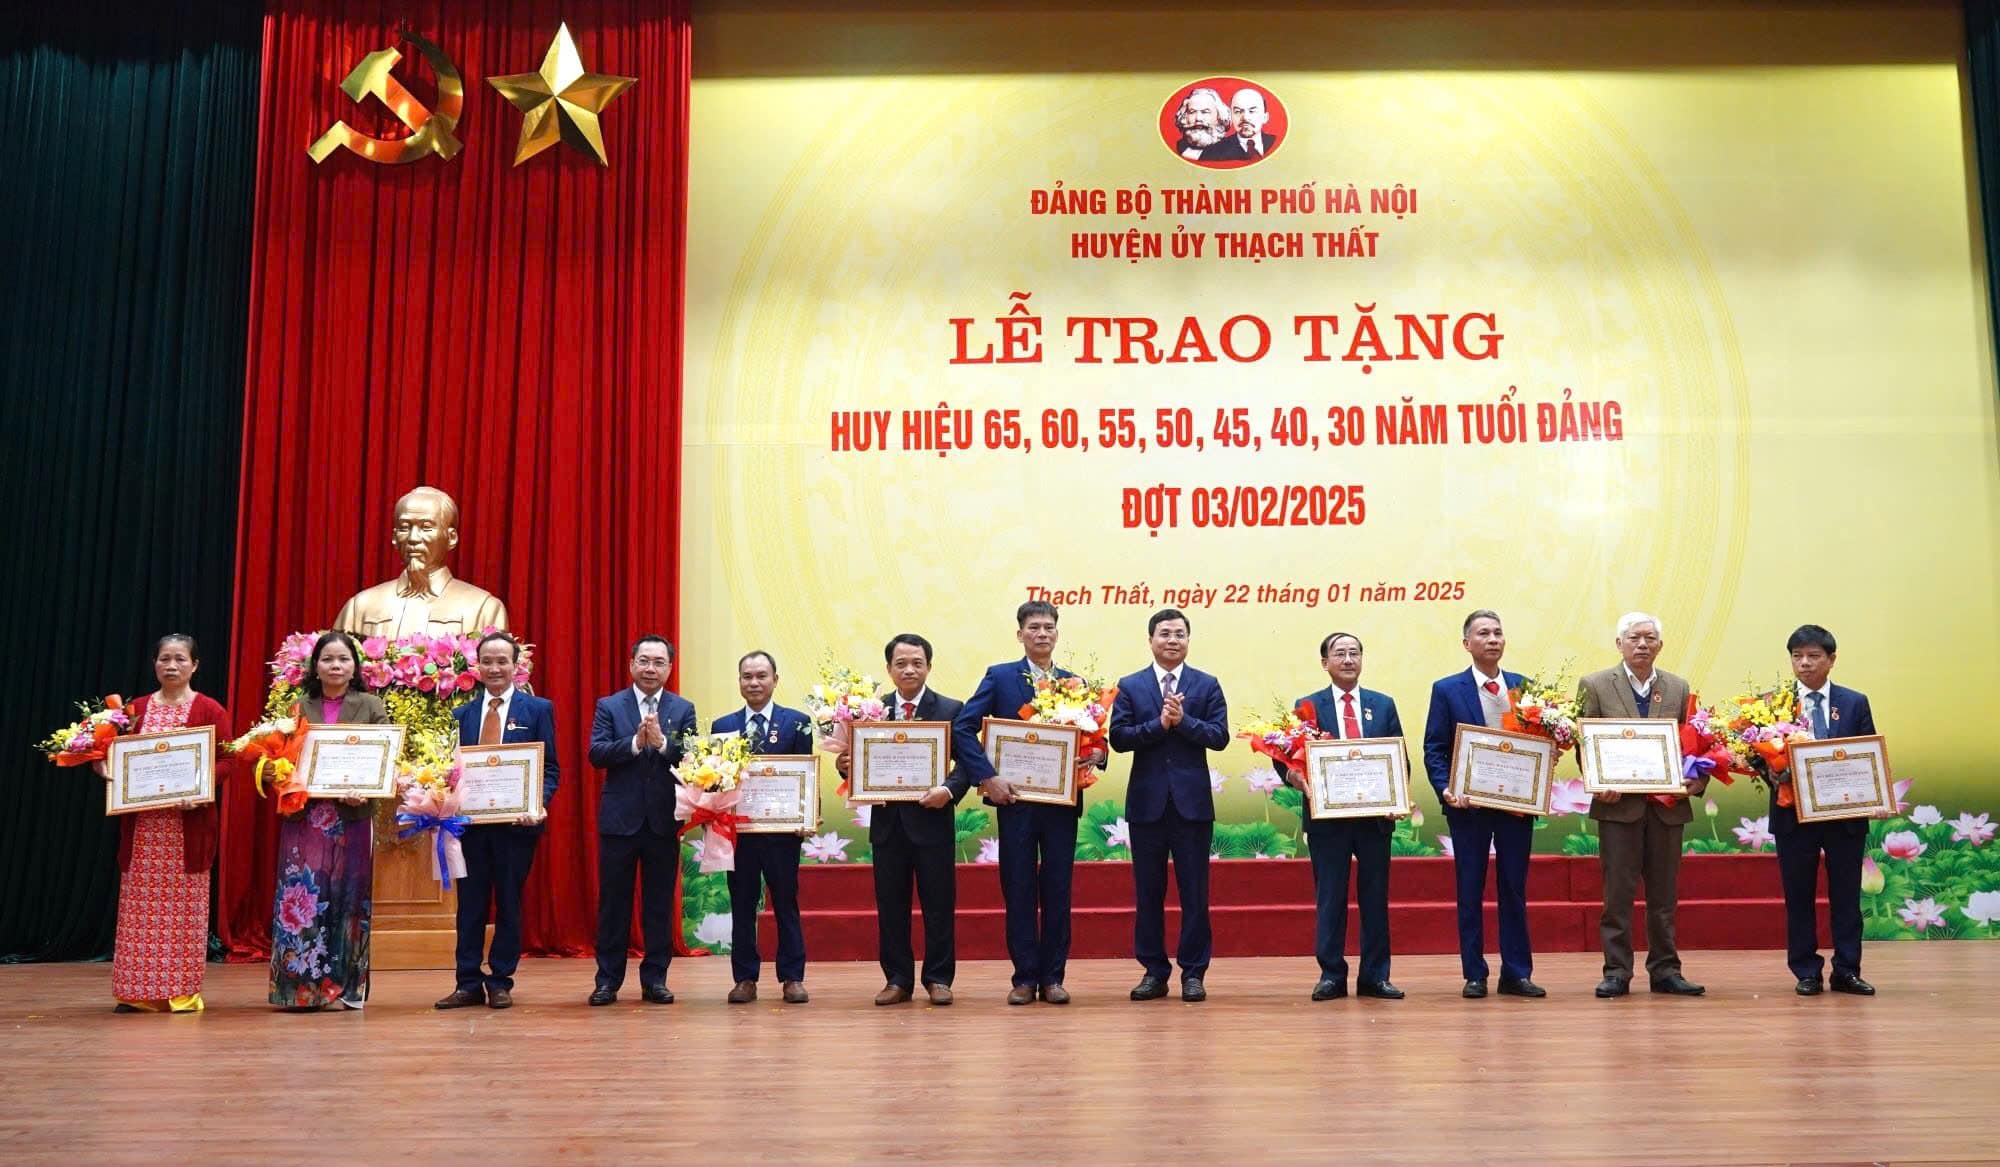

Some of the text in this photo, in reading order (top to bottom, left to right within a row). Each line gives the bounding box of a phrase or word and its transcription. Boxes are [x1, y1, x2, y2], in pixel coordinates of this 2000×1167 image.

[1031, 181, 1418, 220] ĐẢNG BỘ THÀNH PHỐ HÀ NỘI
[1072, 226, 1379, 263] HUYỆN ỦY THẠCH THẤT
[949, 292, 1504, 374] LỄ TRAO TẶNG
[832, 386, 1624, 458] HUY HIỆU 65, 60, 55, 50, 45, 40, 30 NĂM TUỔI ĐẢNG
[1121, 484, 1366, 537] ĐỢT 03/02/2025
[1025, 580, 1465, 608] Thạch Thất, ngày 22 tháng 01 năm 2025
